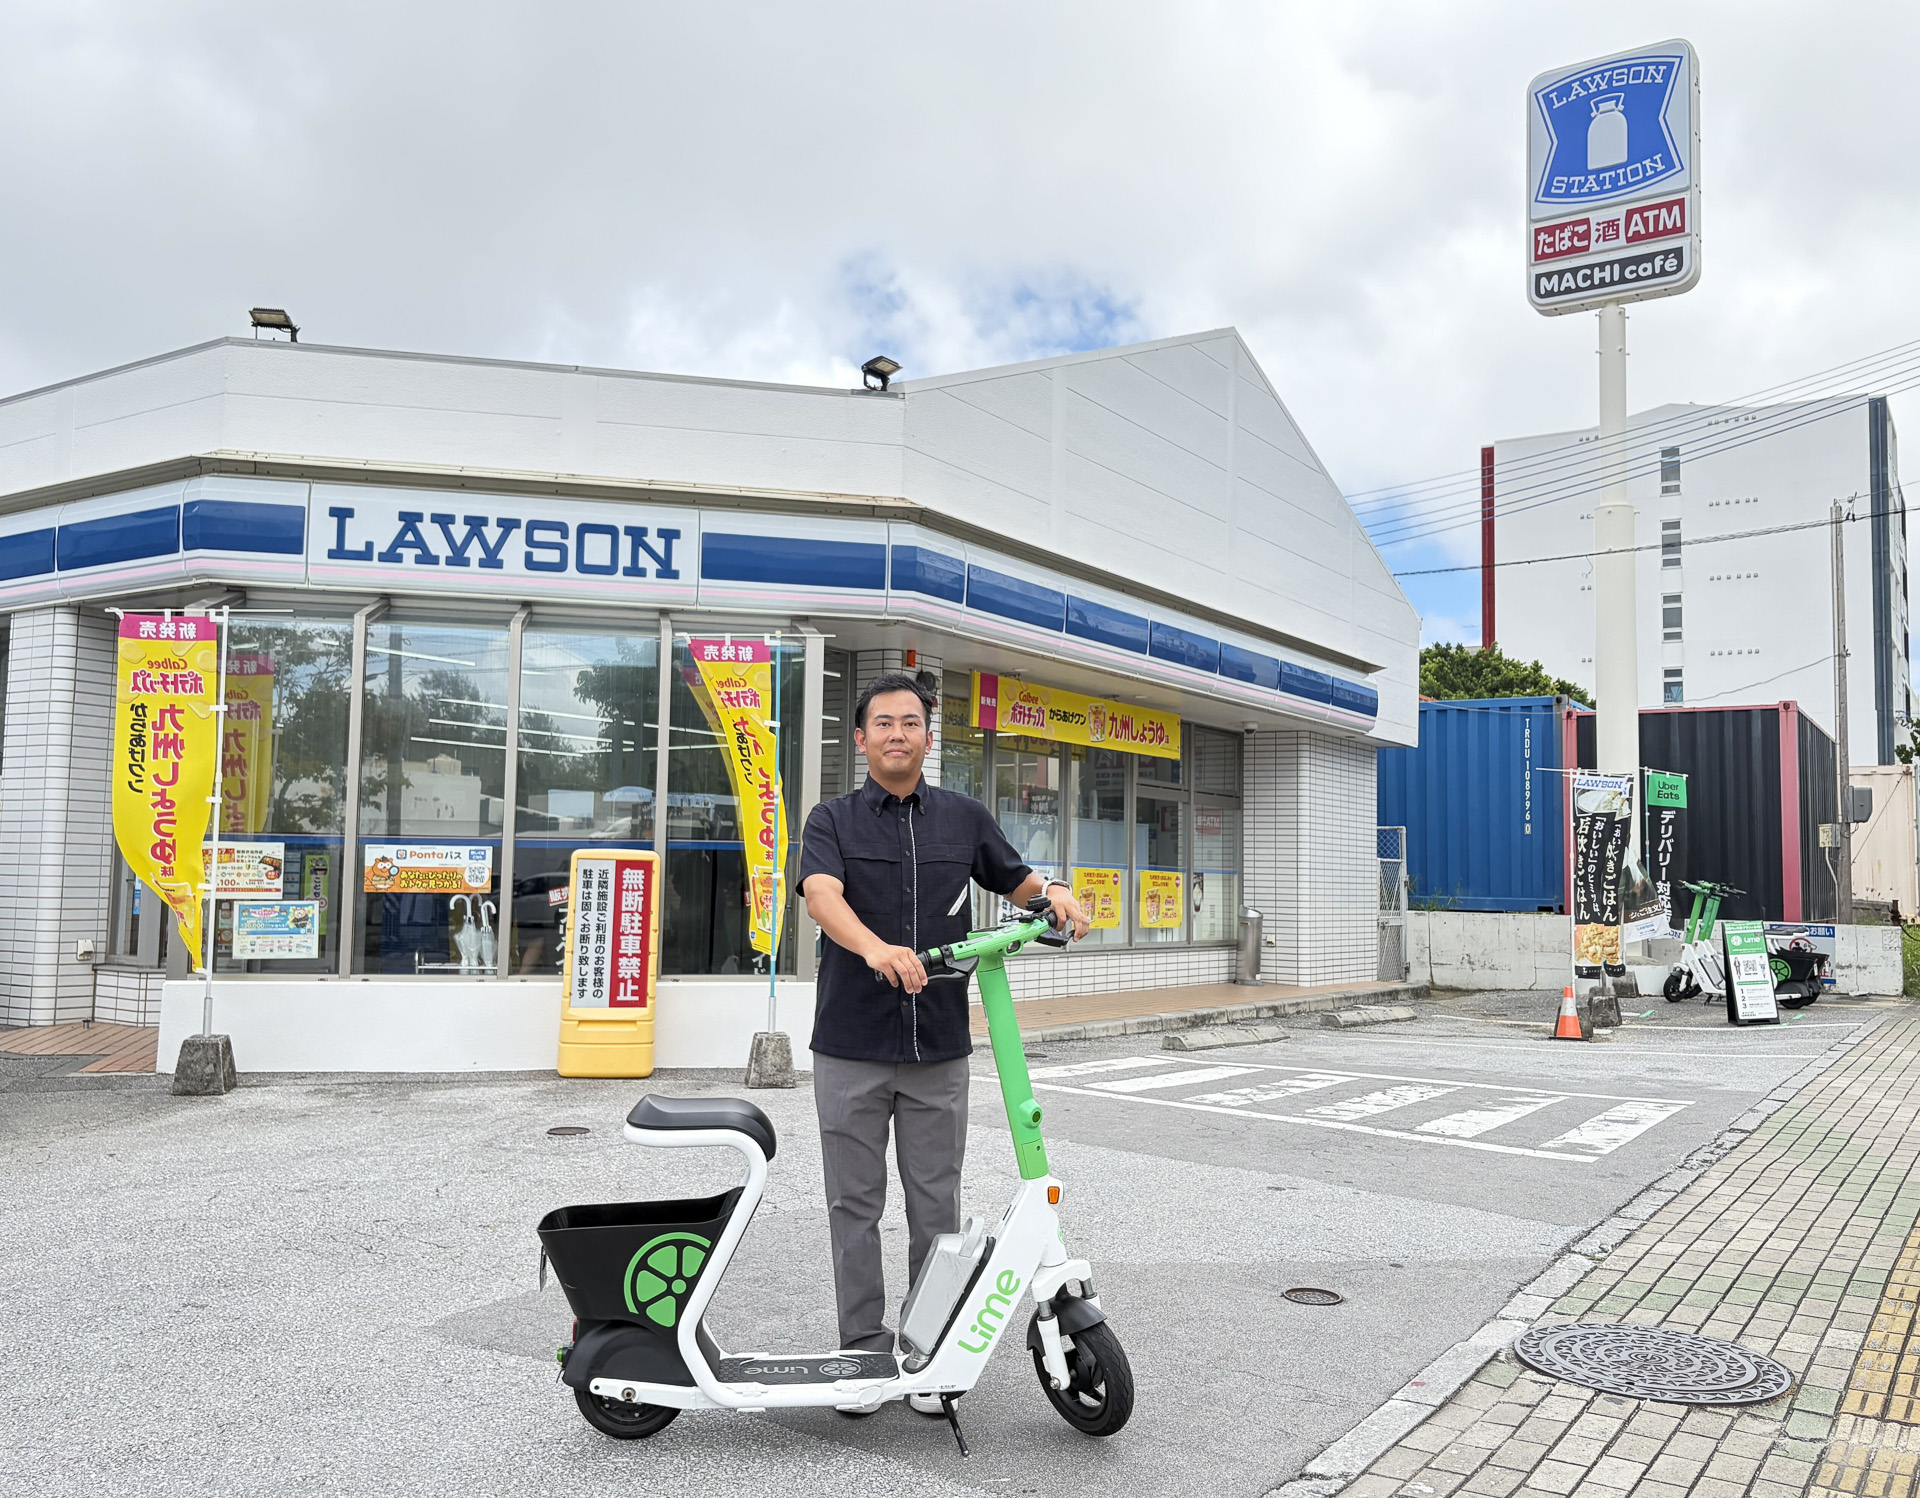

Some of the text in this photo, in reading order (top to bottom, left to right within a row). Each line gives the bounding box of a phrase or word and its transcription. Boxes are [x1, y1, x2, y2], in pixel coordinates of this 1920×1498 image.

[1549, 65, 1668, 110] LAWSON
[1551, 153, 1666, 194] STATION
[1537, 205, 1682, 256] たばこ 酒 ATM
[1539, 253, 1679, 295] MACHI café
[328, 506, 681, 580] LAWSON
[1011, 702, 1046, 730] ポテトチップス
[1019, 691, 1039, 704] Calbee
[1049, 708, 1087, 726] からあげクン
[1576, 778, 1622, 790] LAWSON
[1657, 781, 1679, 791] Uber
[1657, 790, 1680, 800] Eats
[577, 868, 594, 999] 駐車は固くお断り致します
[592, 868, 609, 999] 近隣施設ご利用のお客様の
[617, 868, 645, 1002] 無断駐車禁止
[956, 1268, 1022, 1354] Lime
[744, 1366, 809, 1375] Lime
